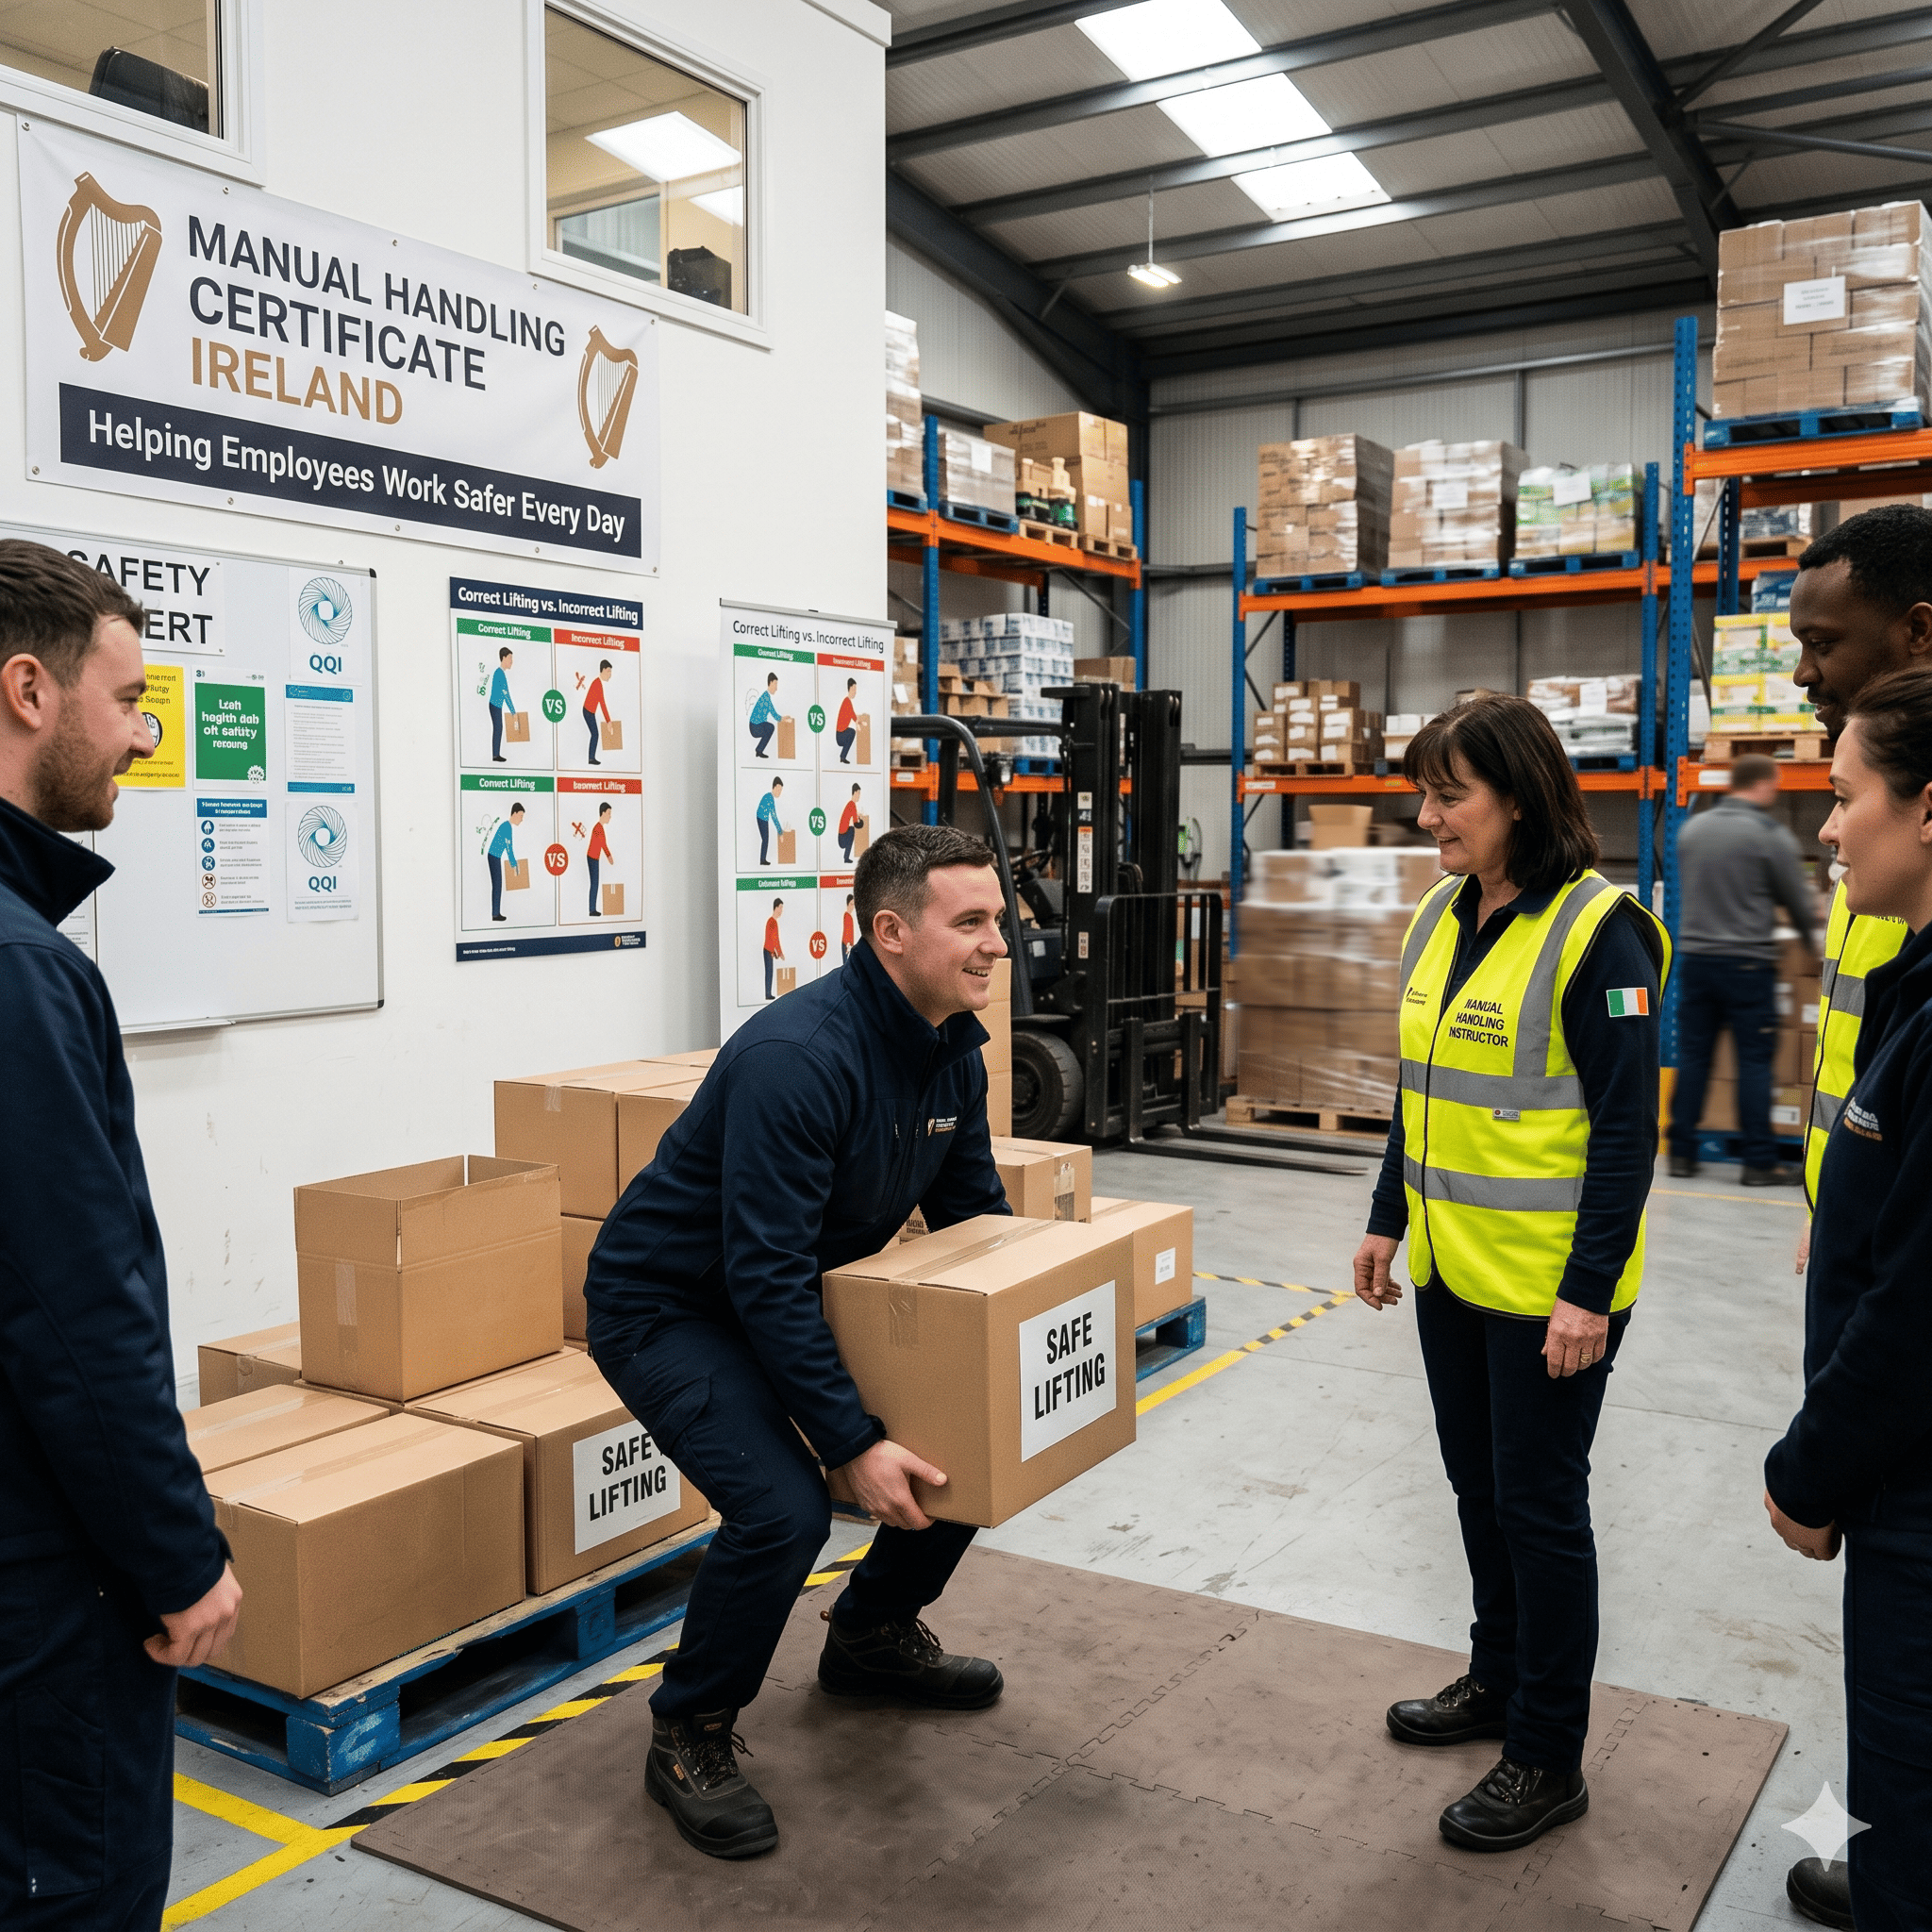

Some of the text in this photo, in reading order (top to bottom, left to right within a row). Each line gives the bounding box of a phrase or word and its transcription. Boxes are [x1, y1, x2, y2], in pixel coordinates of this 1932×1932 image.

[190, 215, 565, 357] MANUAL HANDLING
[190, 276, 486, 391] CERTIFICATE
[192, 338, 403, 425] IRELAND
[89, 409, 625, 543] Helping Employees Work Safer Every Day
[458, 587, 639, 625] Correct Lifting vs. Incorrect Lifting
[477, 624, 506, 636] Correct
[733, 620, 884, 654] Correct Lifting vs. Incorrect Lifting
[309, 654, 342, 675] QQI
[545, 699, 563, 714] VS
[809, 713, 824, 726] VS
[810, 815, 824, 828] VS
[547, 853, 566, 867] VS
[308, 875, 337, 893] QQI
[811, 940, 825, 952] VS
[1046, 1311, 1092, 1365] SAFE
[1034, 1352, 1106, 1421] LIFTING
[602, 1432, 653, 1476] SAFE
[589, 1465, 667, 1522] LIFTING
